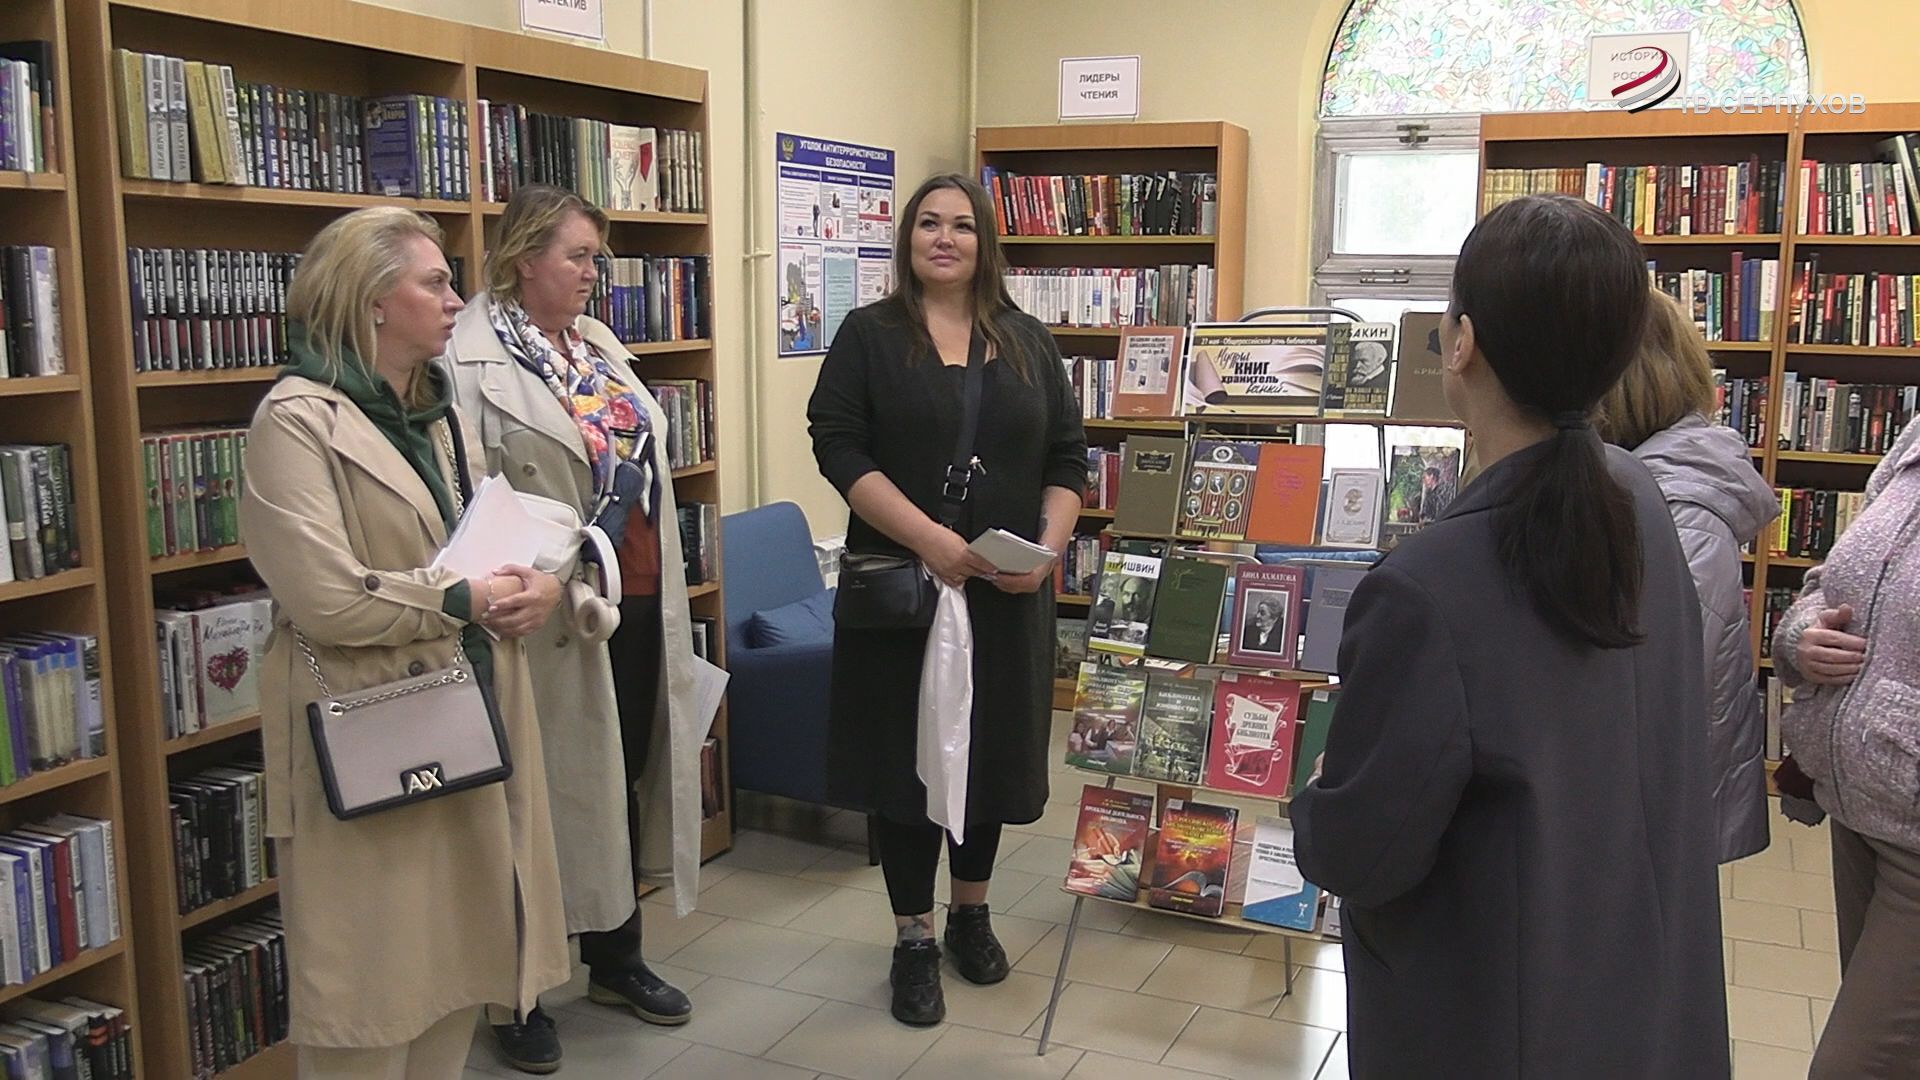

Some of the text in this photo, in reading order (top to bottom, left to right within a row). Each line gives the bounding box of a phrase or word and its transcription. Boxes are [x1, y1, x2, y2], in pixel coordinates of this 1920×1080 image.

[1610, 51, 1665, 62] ИСТОРИ
[1079, 73, 1120, 83] ЛИДЕРЫ
[1080, 90, 1118, 99] ЧТЕНИЯ
[800, 140, 888, 161] УГОЛОК АНТИТЕРРОРИСТИЧЕСКОЙ
[825, 157, 867, 170] БЕЗОПАСНОСТИ
[1334, 328, 1388, 338] РУБАКИН
[1223, 337, 1271, 346] Общероссийский
[1286, 337, 1317, 345] библиотек
[1234, 362, 1270, 375] КНИГ
[1221, 375, 1279, 384] хранитель
[1108, 561, 1155, 574] ПРИШВИН
[1241, 571, 1296, 581] АННА АХМАТОВА
[1158, 691, 1201, 701] БИБЛИОТЕКА
[1244, 711, 1268, 721] СУДЬБЫ
[1240, 721, 1268, 731] ДРЕВНИХ
[1236, 729, 1270, 740] БИБЛИОТЕК
